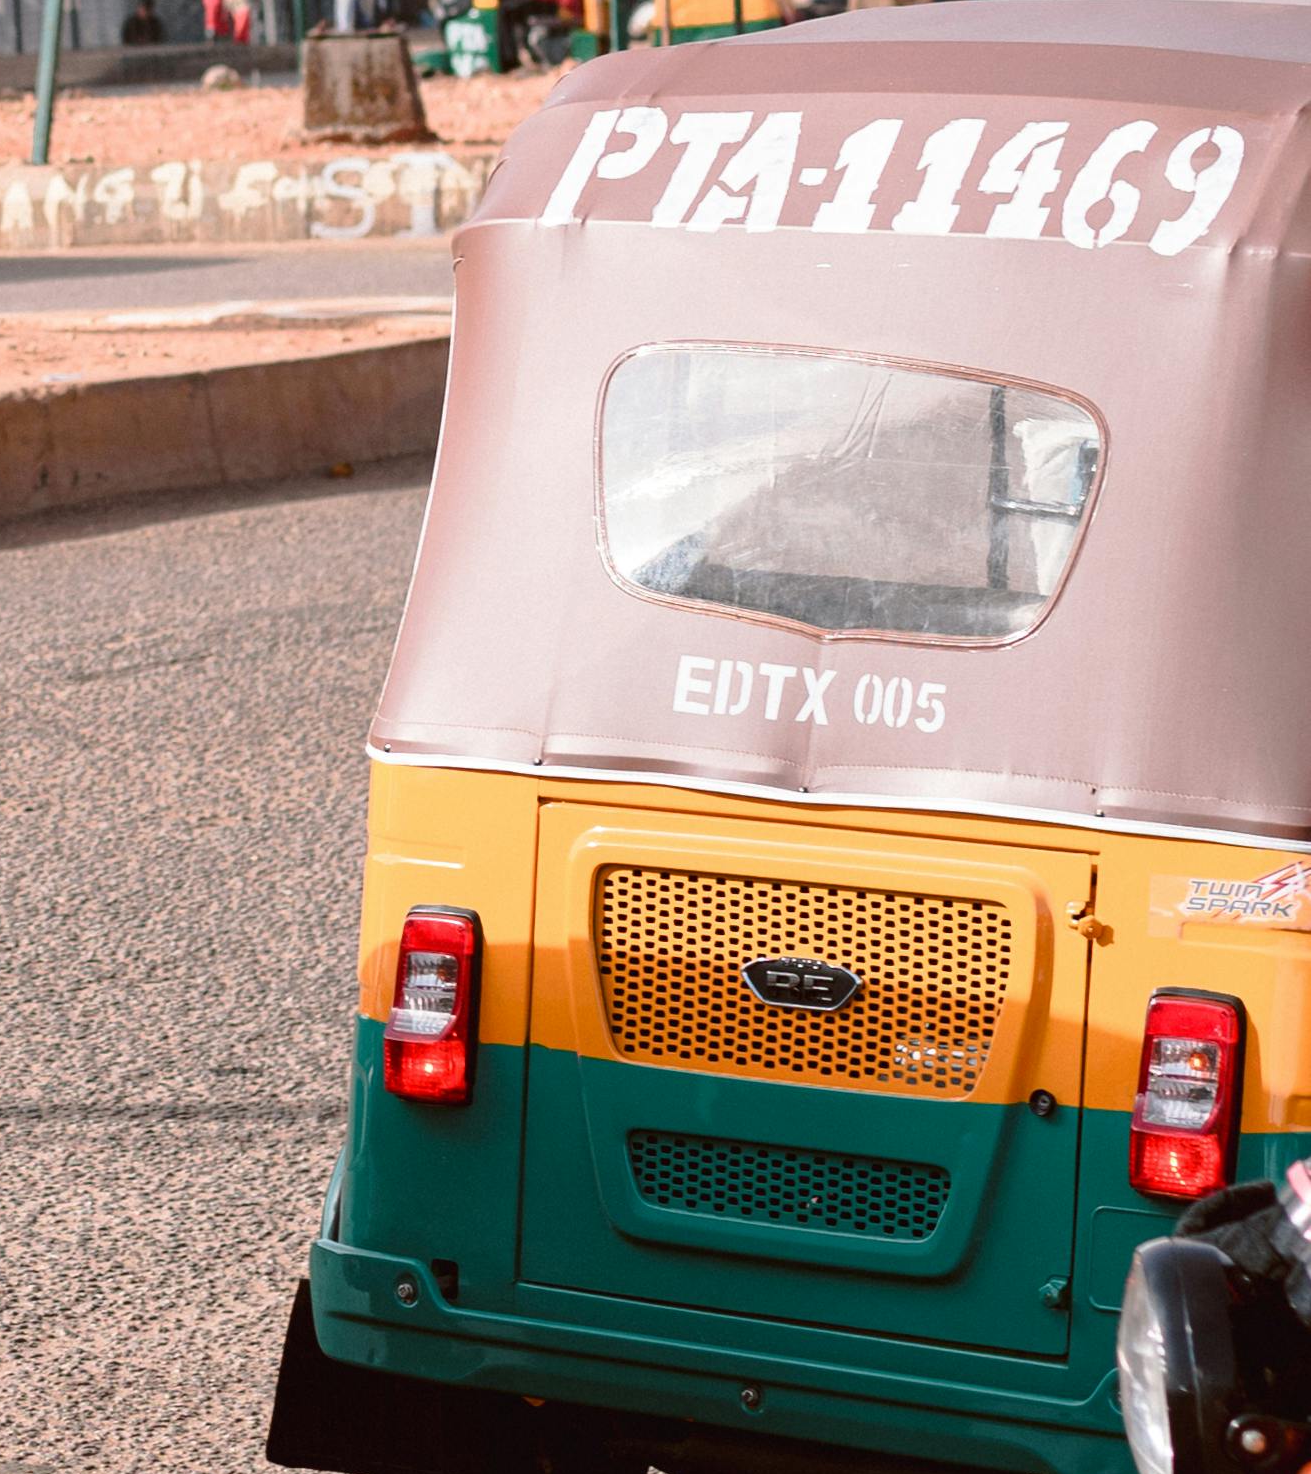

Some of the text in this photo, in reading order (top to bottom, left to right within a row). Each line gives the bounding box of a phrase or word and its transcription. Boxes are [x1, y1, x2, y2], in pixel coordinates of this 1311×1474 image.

[539, 105, 1247, 257] PTA-11469
[672, 654, 947, 734] EDTX 005
[1190, 880, 1264, 899] TWIN
[1186, 897, 1294, 918] SPARK
[765, 970, 835, 1002] RE
